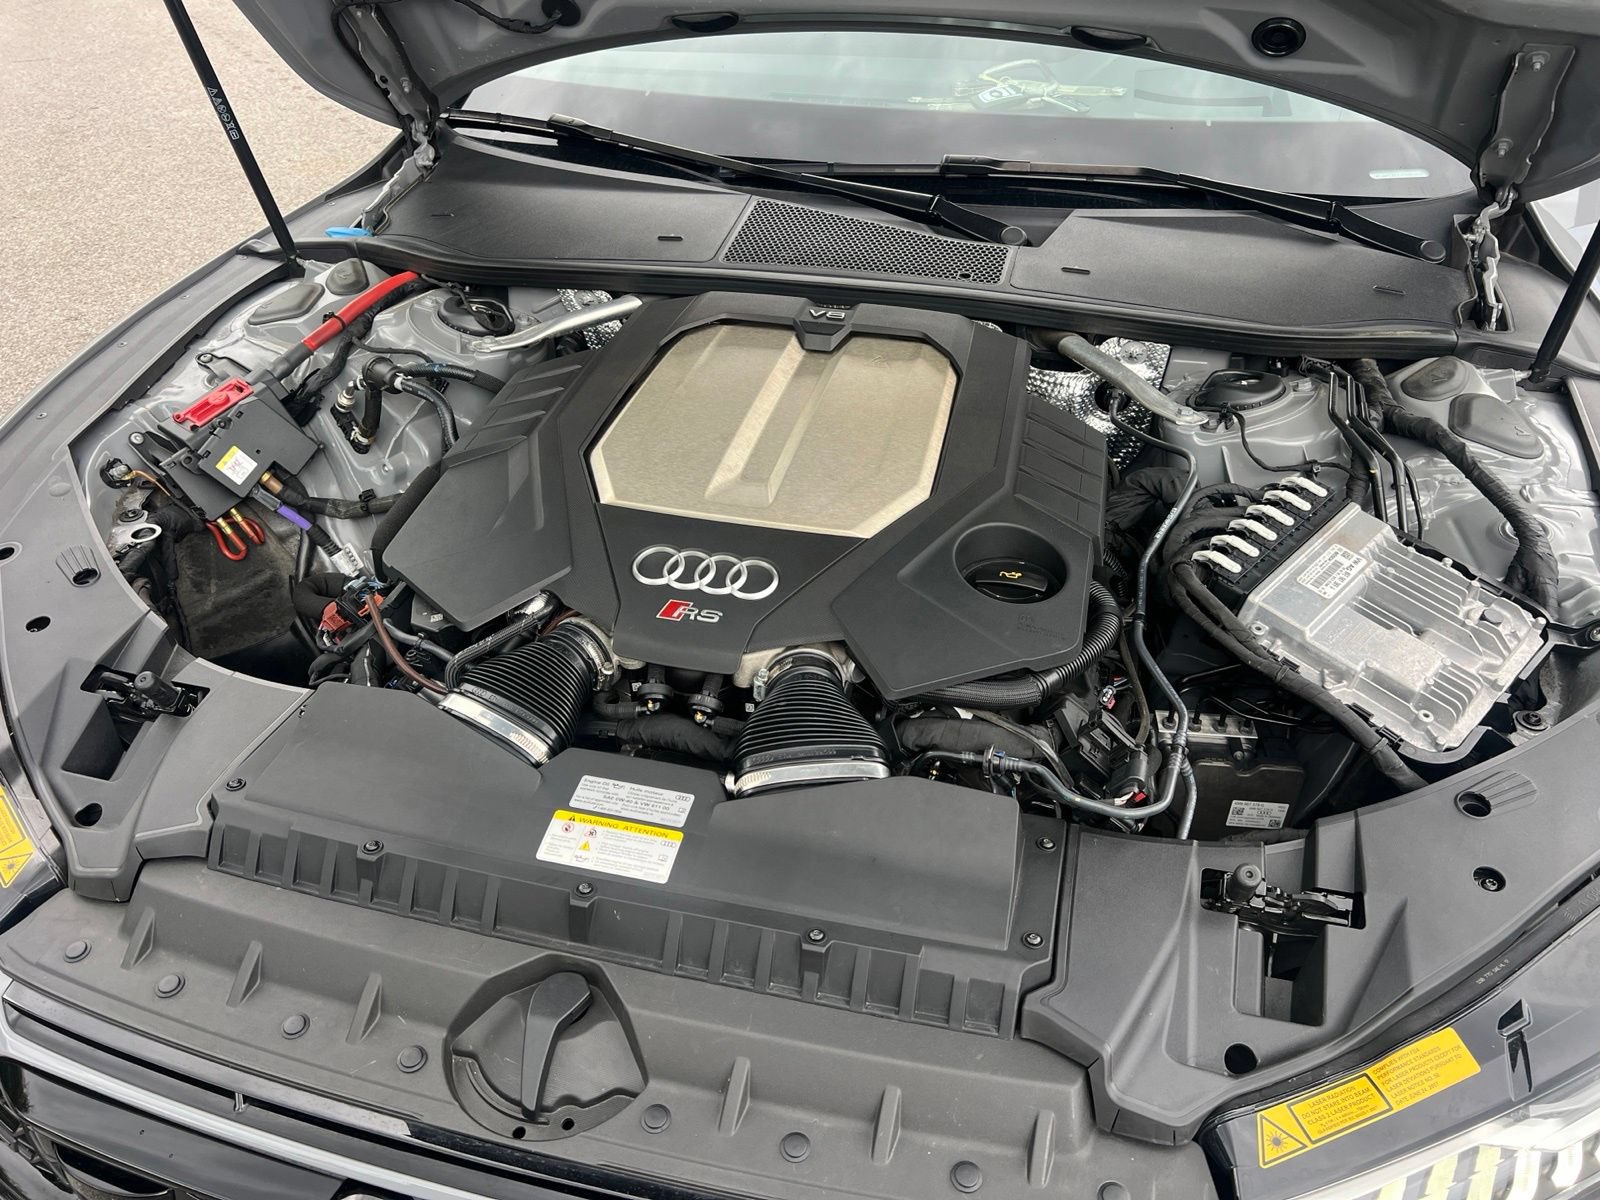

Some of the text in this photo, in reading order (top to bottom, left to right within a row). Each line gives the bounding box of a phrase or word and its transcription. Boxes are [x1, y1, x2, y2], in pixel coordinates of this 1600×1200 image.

[809, 309, 846, 320] V8
[578, 817, 669, 838] WARNING ATTENTION
[1373, 1058, 1397, 1074] COMPLIES
[1377, 1060, 1411, 1080] PERFORMANCE
[1395, 1069, 1408, 1080] LASER
[1386, 1081, 1402, 1092] LASER
[1392, 1088, 1407, 1099] LASER
[1408, 1080, 1424, 1091] NOTICE
[1308, 1086, 1356, 1108] LASER RADIATION
[1311, 1108, 1322, 1116] NOT
[1323, 1100, 1340, 1112] STARE
[1341, 1094, 1354, 1102] INTO
[1355, 1088, 1370, 1097] BEAM
[1308, 1114, 1326, 1125] CLASS
[1332, 1105, 1348, 1115] LASER
[1349, 1094, 1375, 1107] PRODUCT
